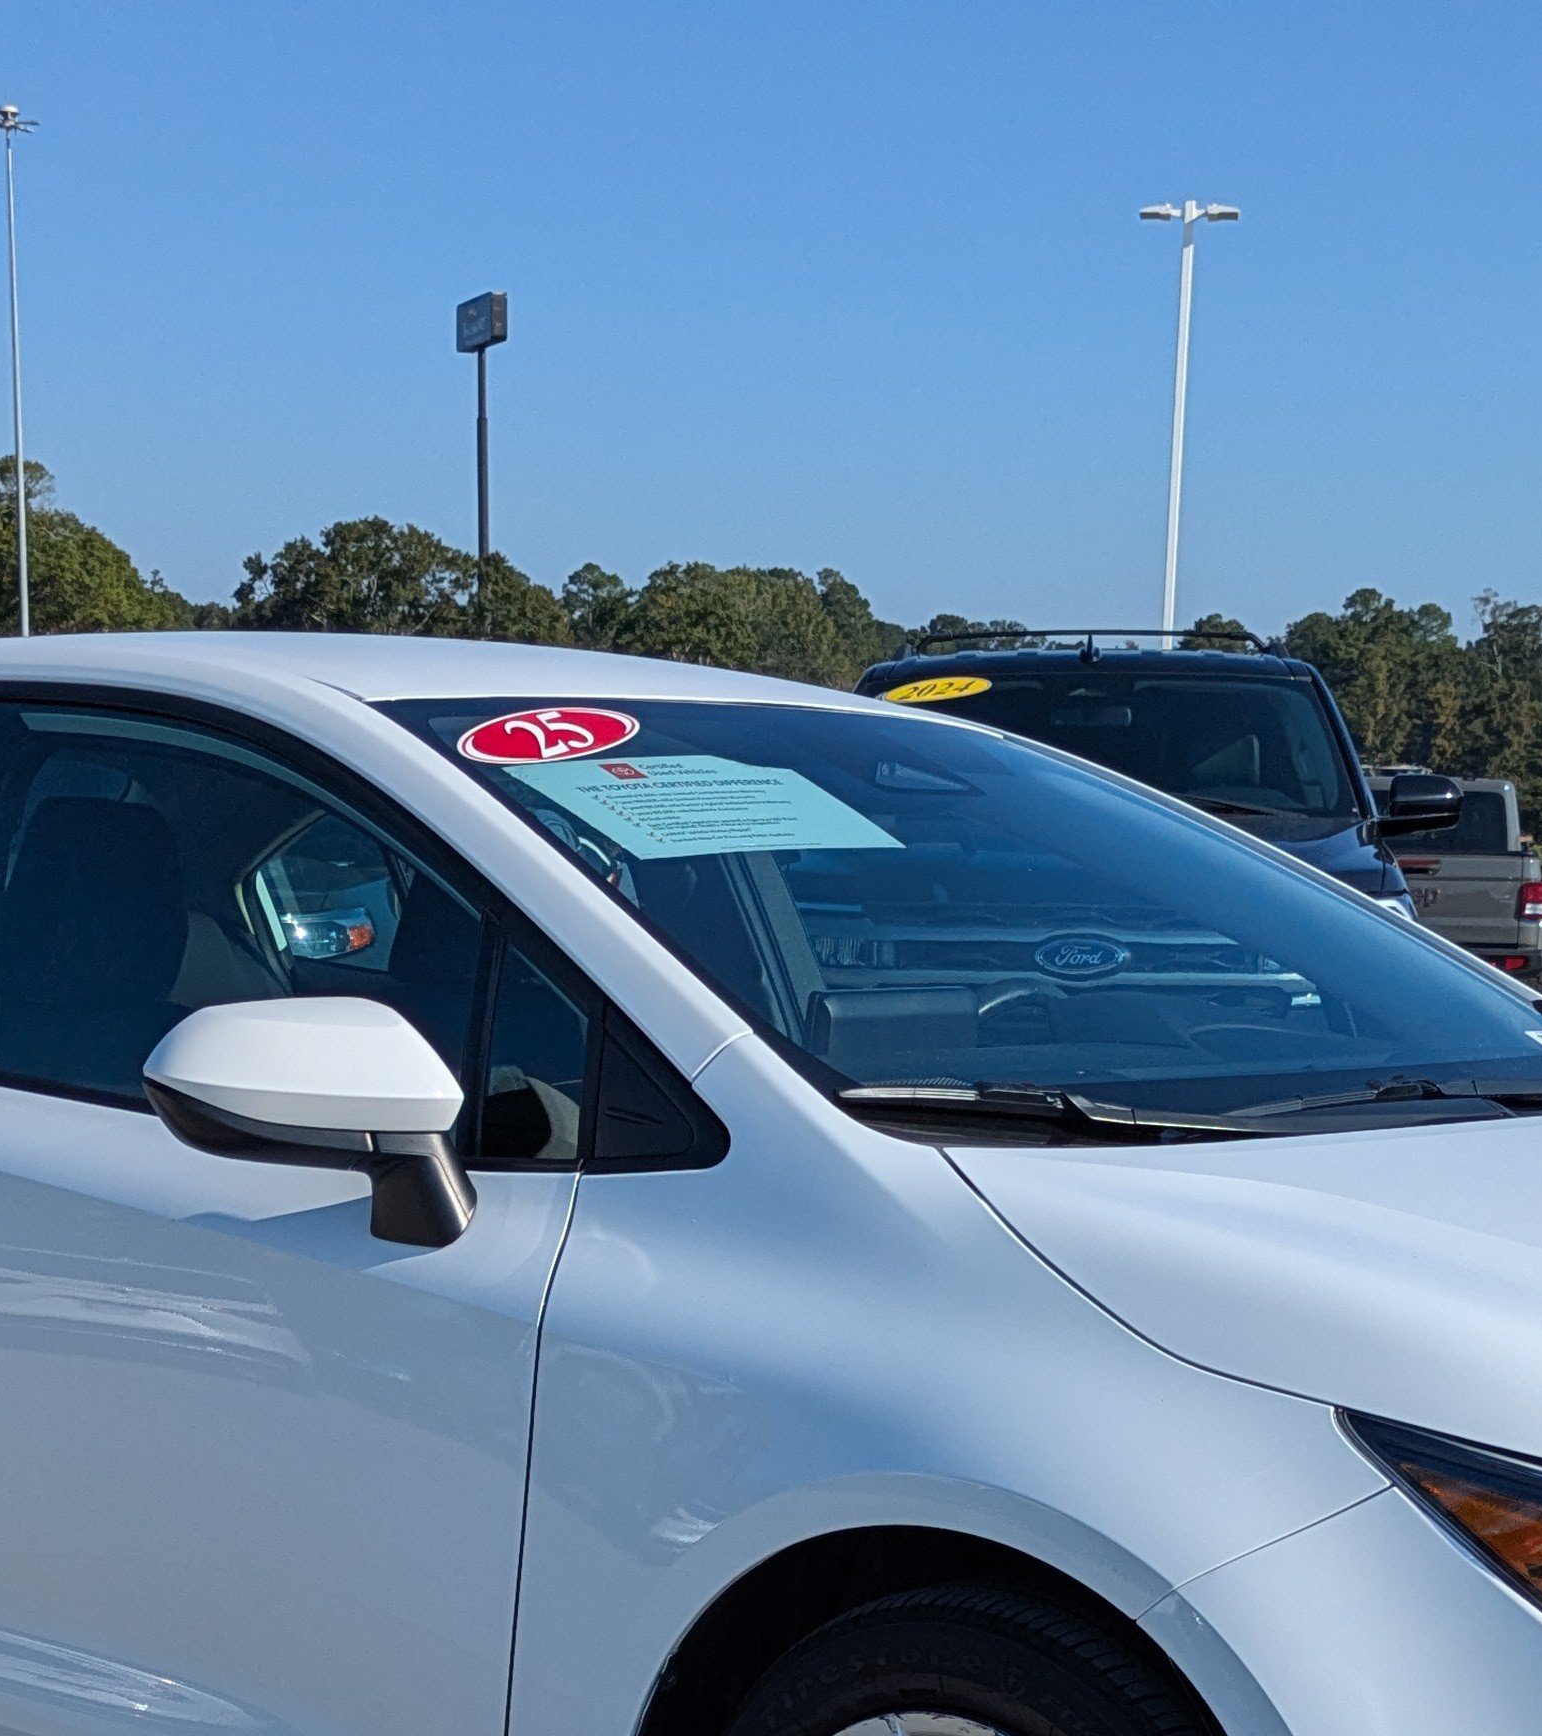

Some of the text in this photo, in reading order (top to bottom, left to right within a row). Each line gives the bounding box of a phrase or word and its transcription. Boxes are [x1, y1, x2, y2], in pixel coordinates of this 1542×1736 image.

[896, 680, 976, 701] 2024
[504, 710, 595, 758] 25
[600, 782, 653, 791] TOYOTA
[1055, 945, 1103, 966] Ford
